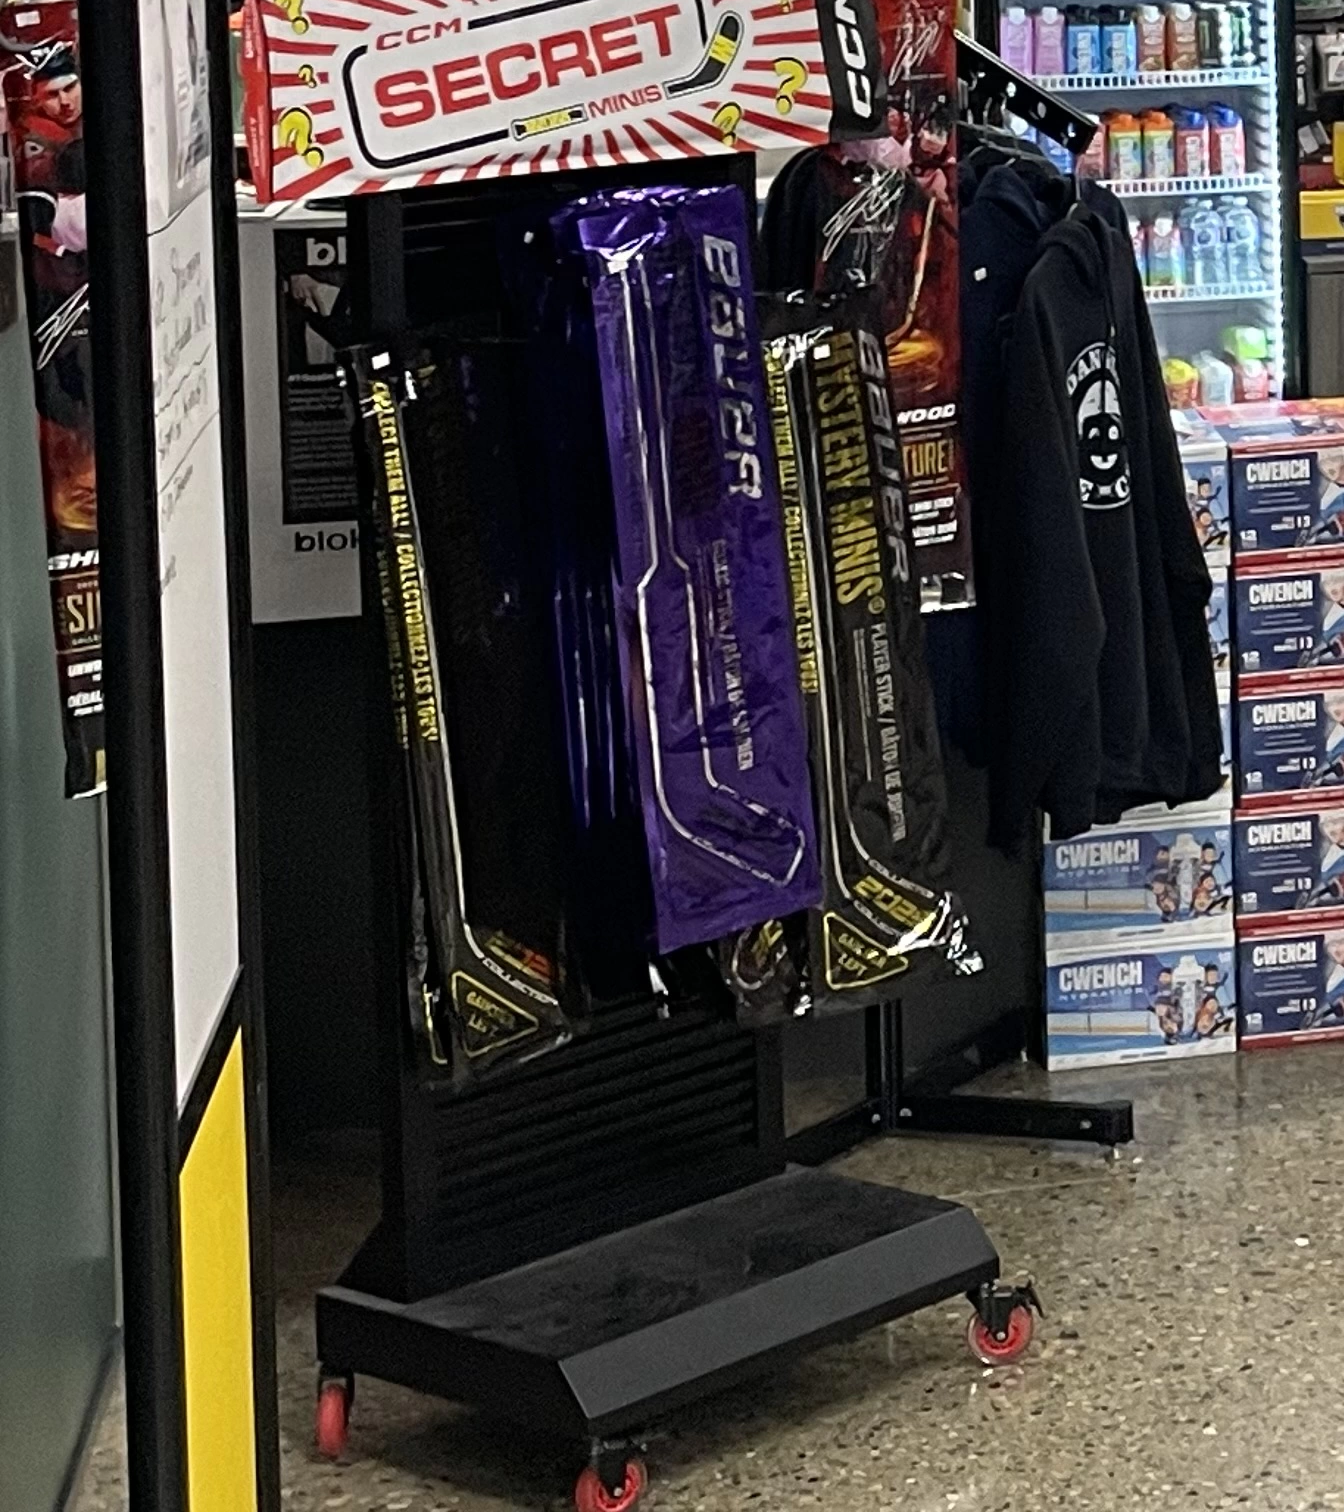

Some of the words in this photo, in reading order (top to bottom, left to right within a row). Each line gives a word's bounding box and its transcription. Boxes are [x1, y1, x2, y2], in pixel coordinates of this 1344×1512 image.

[375, 16, 463, 51] CCM
[372, 4, 682, 130] SECRET
[587, 84, 664, 118] MINIS
[306, 236, 348, 267] bl
[702, 233, 764, 501] BAUER
[813, 330, 872, 492] MYSTERY
[897, 402, 957, 426] WOOD
[857, 328, 910, 584] BAUER
[902, 439, 948, 479] TURE
[1246, 458, 1311, 483] CWENCH
[829, 496, 884, 606] MINIS
[1249, 579, 1314, 605] CWENCH
[870, 621, 891, 674] PLAYER
[874, 675, 894, 715] STICK
[1252, 700, 1317, 725] CWENCH
[1247, 820, 1312, 846] CWENCH
[1055, 838, 1140, 871] CWENCH
[1252, 941, 1317, 966] CWENCH
[1058, 960, 1143, 993] CWENCH
